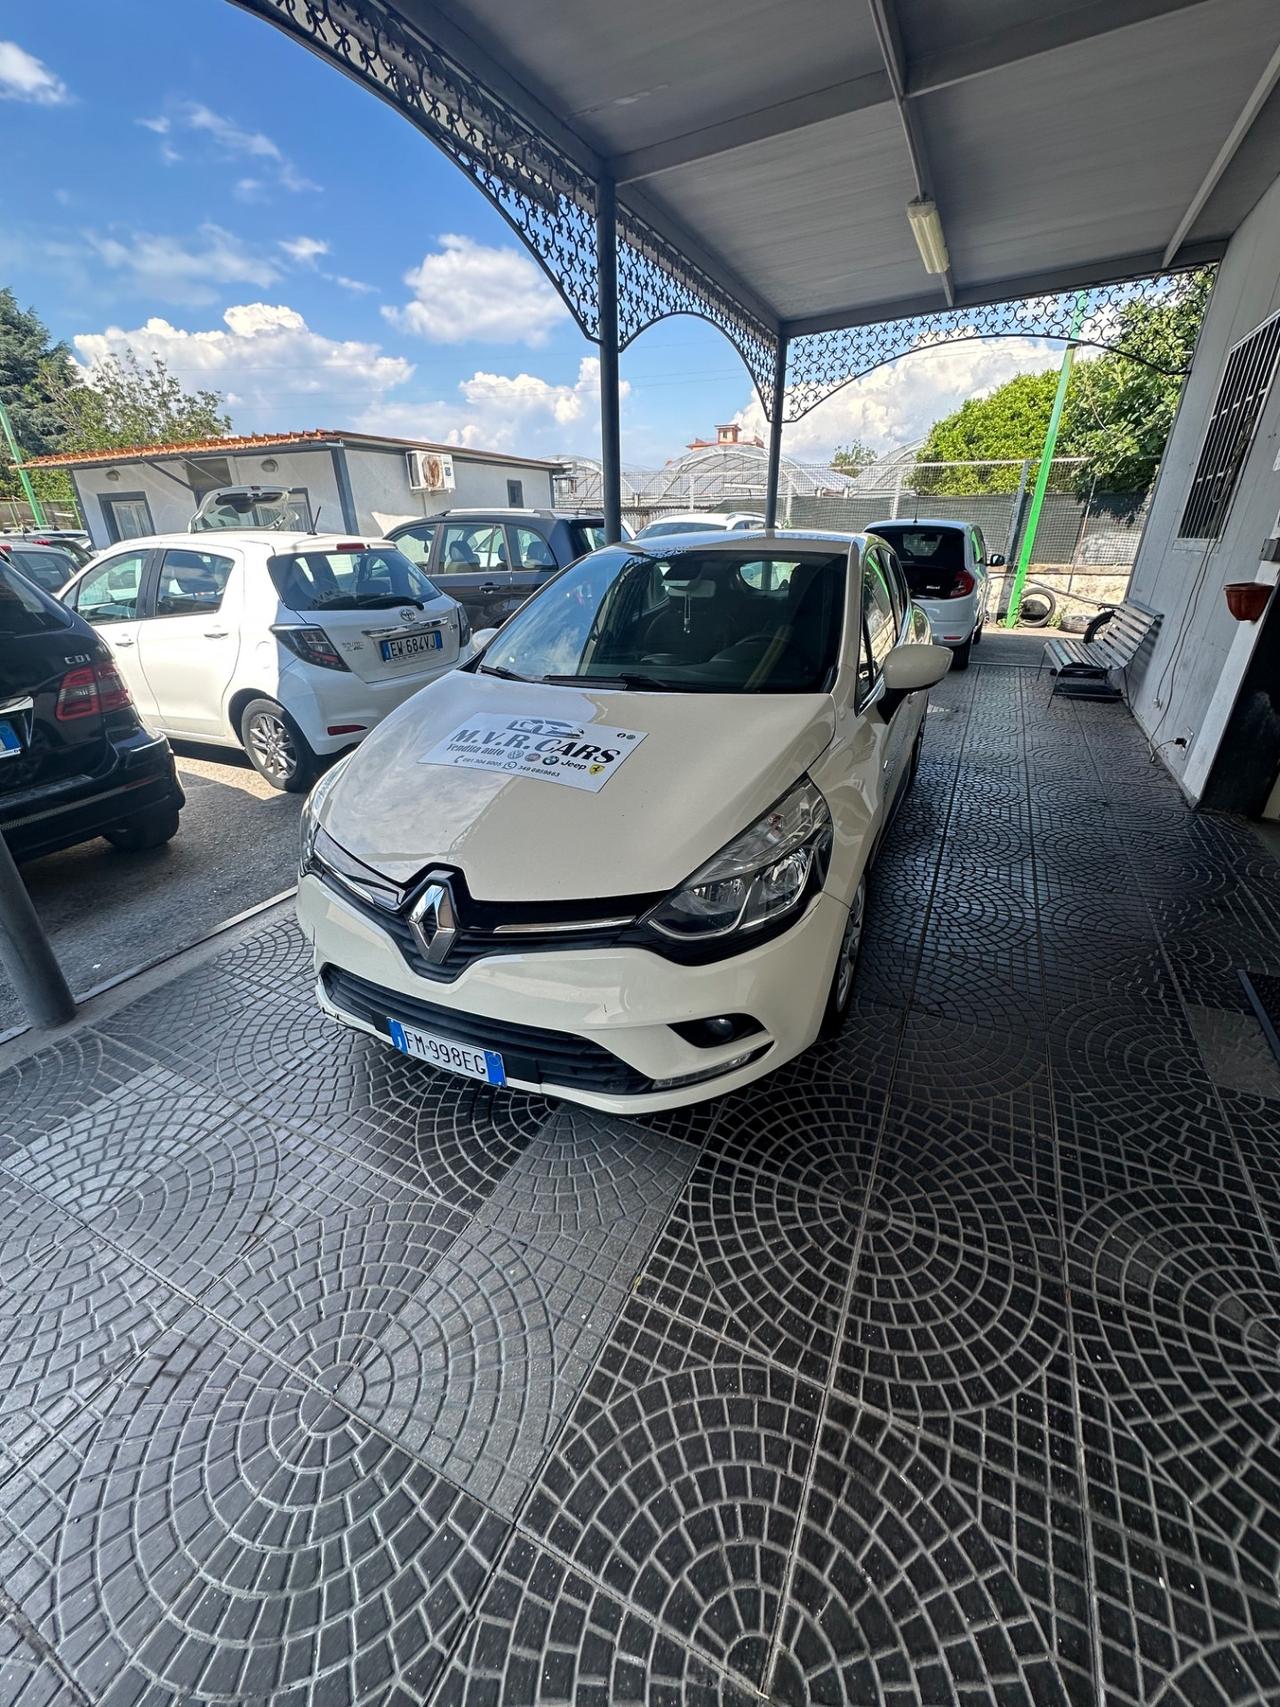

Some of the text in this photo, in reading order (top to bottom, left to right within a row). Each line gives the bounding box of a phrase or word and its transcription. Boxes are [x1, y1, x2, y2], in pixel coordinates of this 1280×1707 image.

[64, 653, 91, 665] CDI
[447, 743, 505, 757] Vendita auto
[561, 759, 587, 771] Jeep
[404, 1030, 426, 1055] FM
[428, 1040, 487, 1075] 998EG
